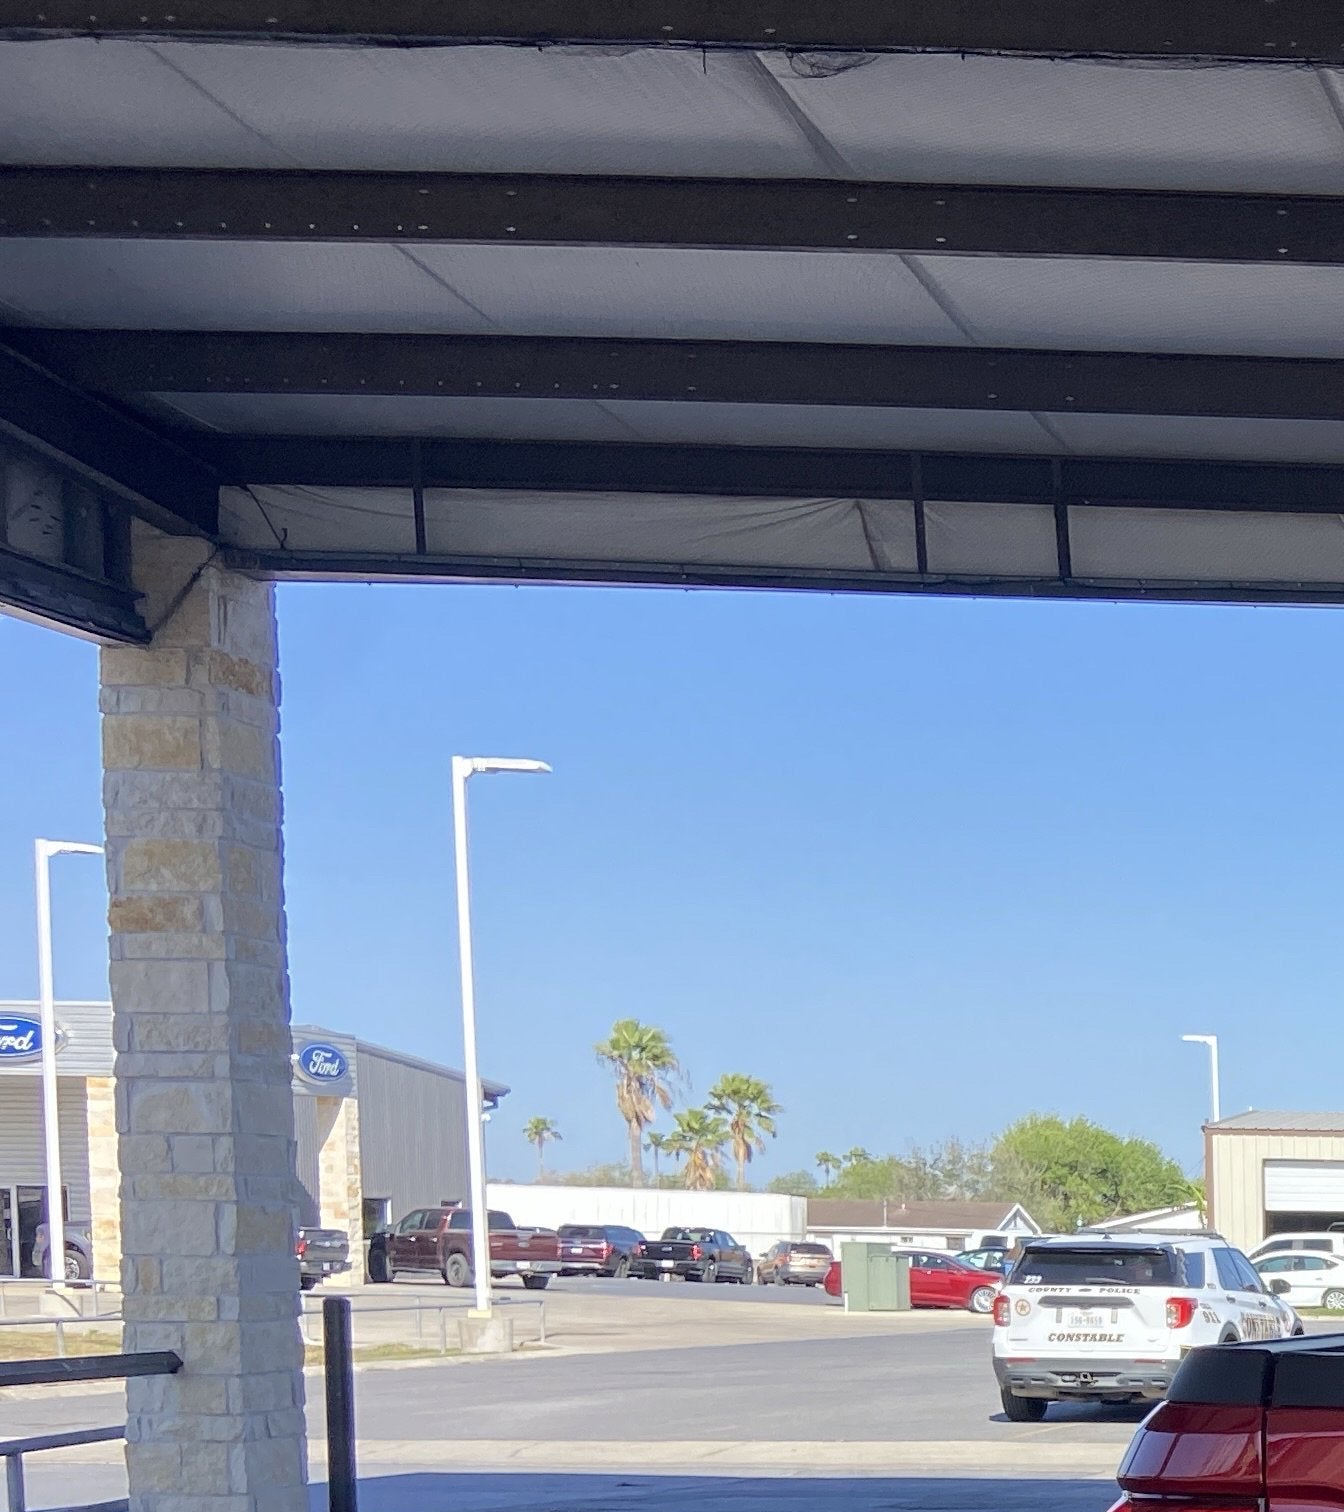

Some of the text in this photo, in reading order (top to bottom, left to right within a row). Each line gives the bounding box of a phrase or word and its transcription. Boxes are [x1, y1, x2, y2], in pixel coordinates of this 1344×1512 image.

[0, 1025, 35, 1051] rd
[309, 1050, 340, 1076] Ford
[1048, 1333, 1124, 1342] CONSTABLE
